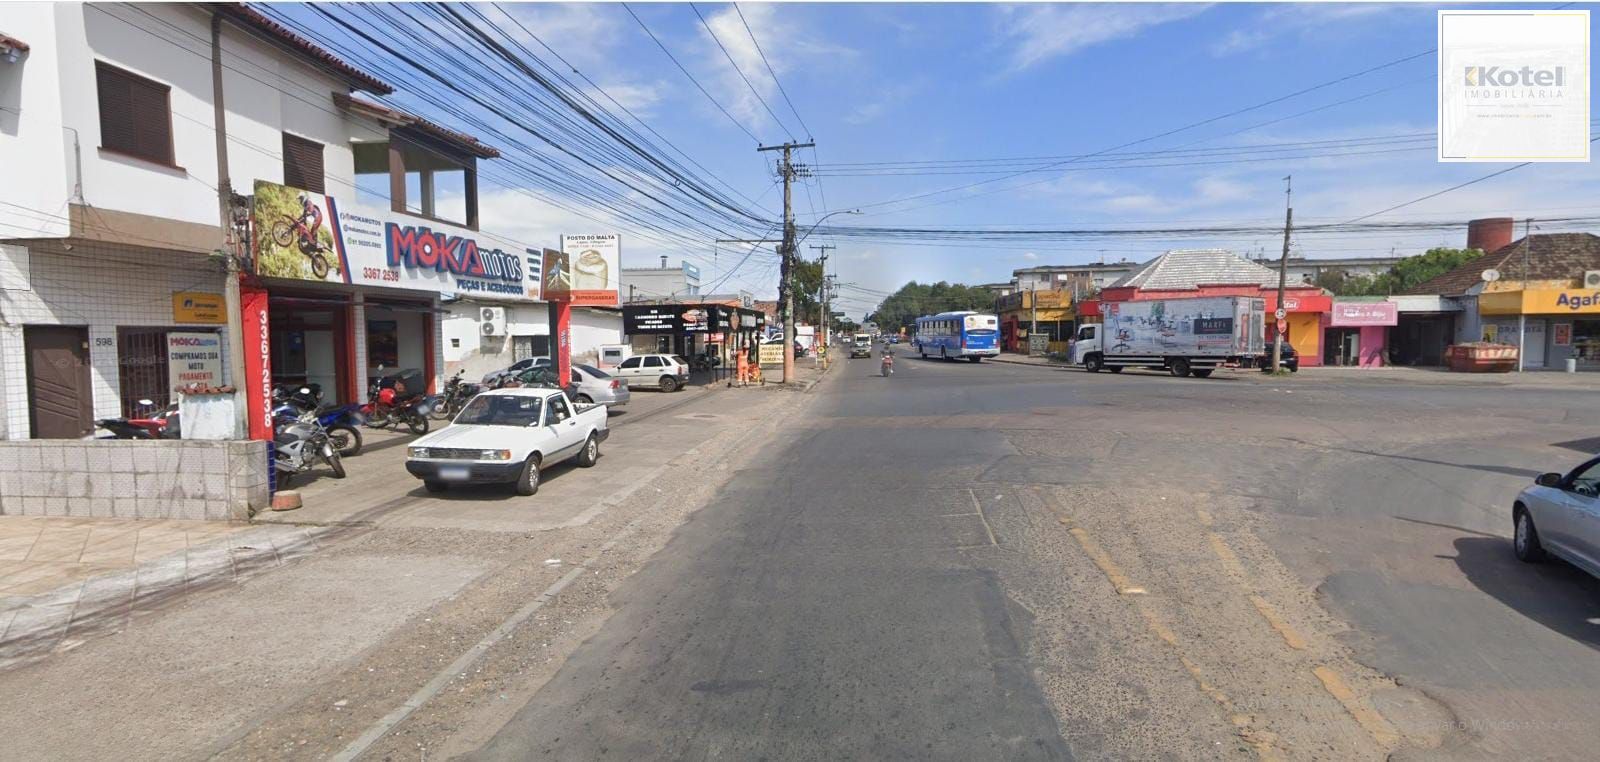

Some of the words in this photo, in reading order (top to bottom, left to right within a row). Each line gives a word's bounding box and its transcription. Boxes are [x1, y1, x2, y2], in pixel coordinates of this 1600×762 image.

[363, 267, 381, 279] 3367
[382, 269, 399, 281] 2538
[456, 279, 480, 292] PEÇAS
[480, 282, 487, 291] E
[170, 352, 207, 360] COMPRAMOS
[188, 362, 204, 370] MOTO
